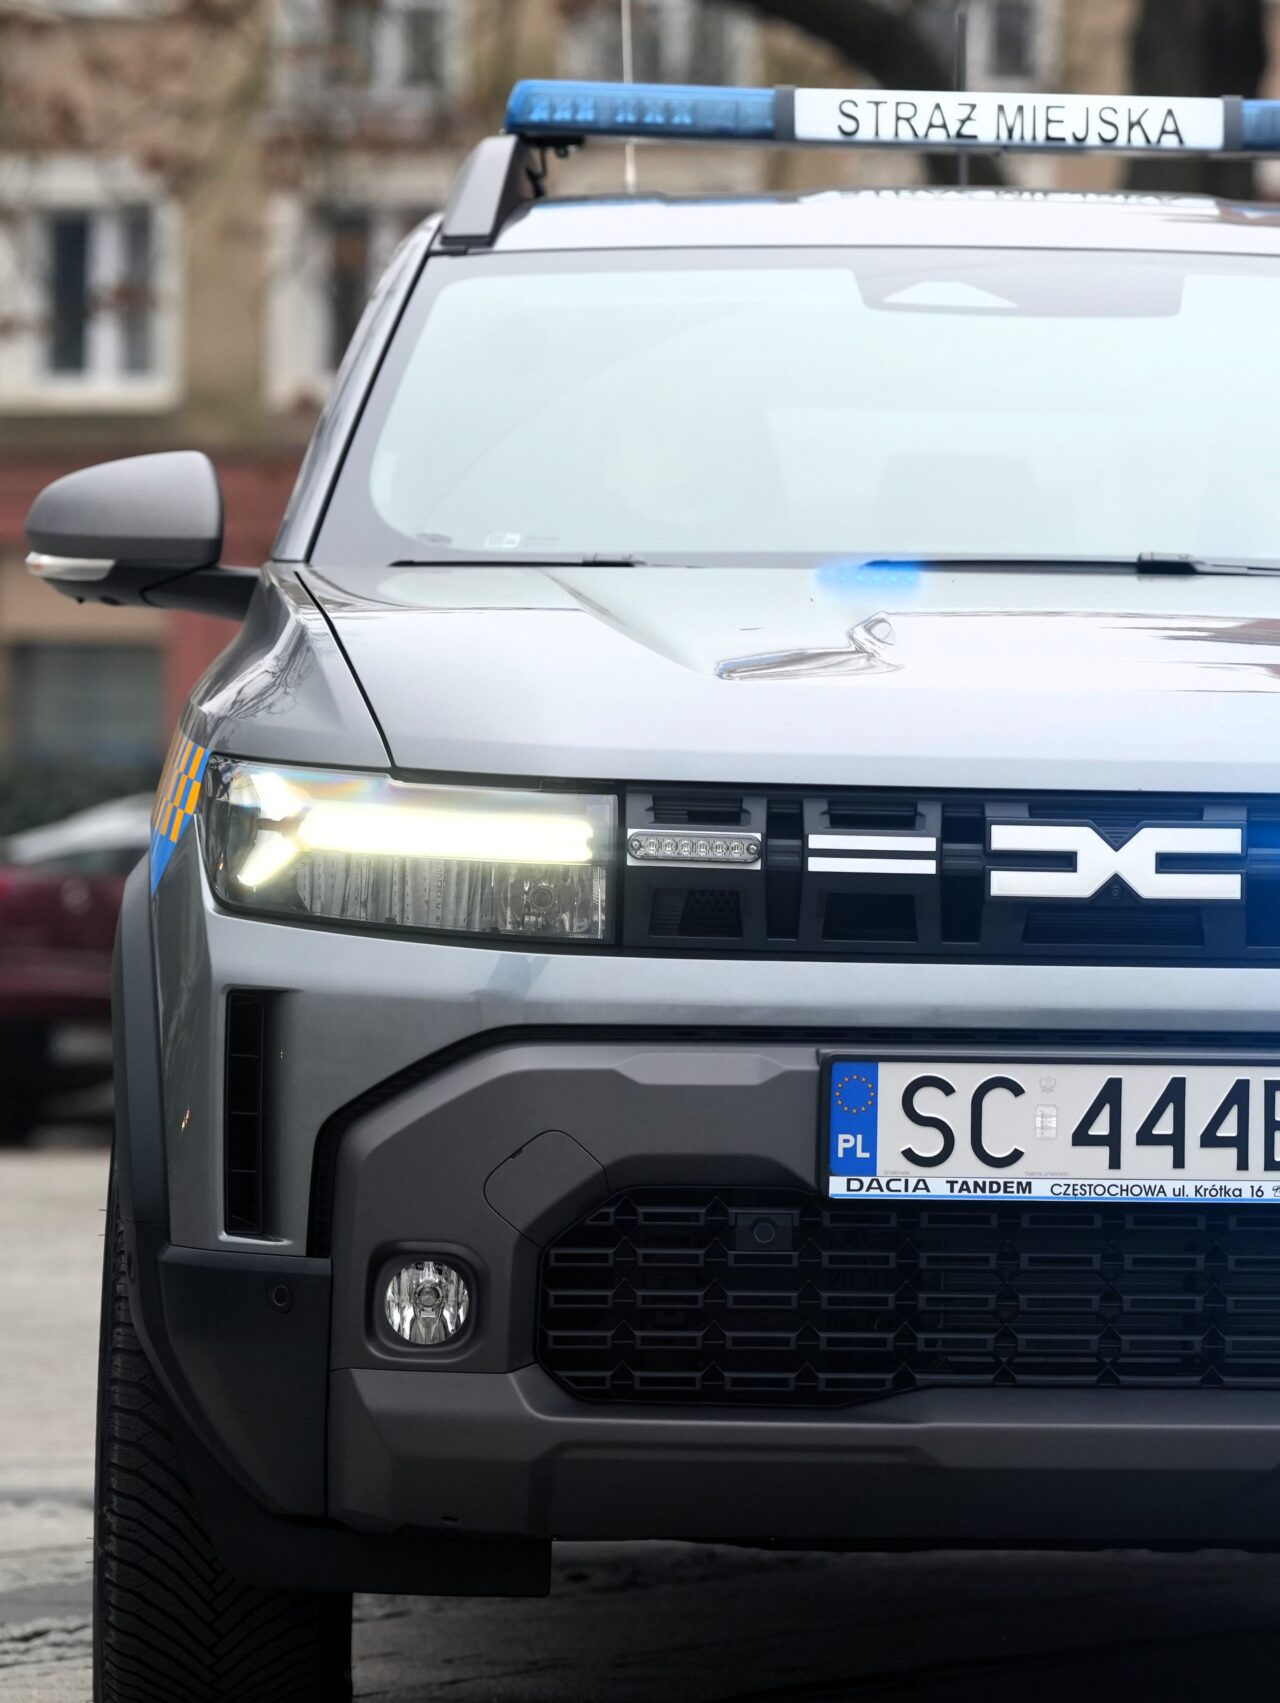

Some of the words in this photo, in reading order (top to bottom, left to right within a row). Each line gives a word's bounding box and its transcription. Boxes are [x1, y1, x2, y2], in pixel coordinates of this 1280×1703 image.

[995, 104, 1184, 146] MIEJSKA
[901, 1075, 1025, 1169] SC
[838, 1134, 870, 1158] PL
[847, 1178, 931, 1193] DACIA
[946, 1180, 1032, 1195] TANDEM
[1050, 1183, 1167, 1198] CZĘSTOCHOWA
[1172, 1184, 1189, 1198] ul.
[1194, 1184, 1243, 1198] Krótka
[1249, 1185, 1264, 1198] 16
